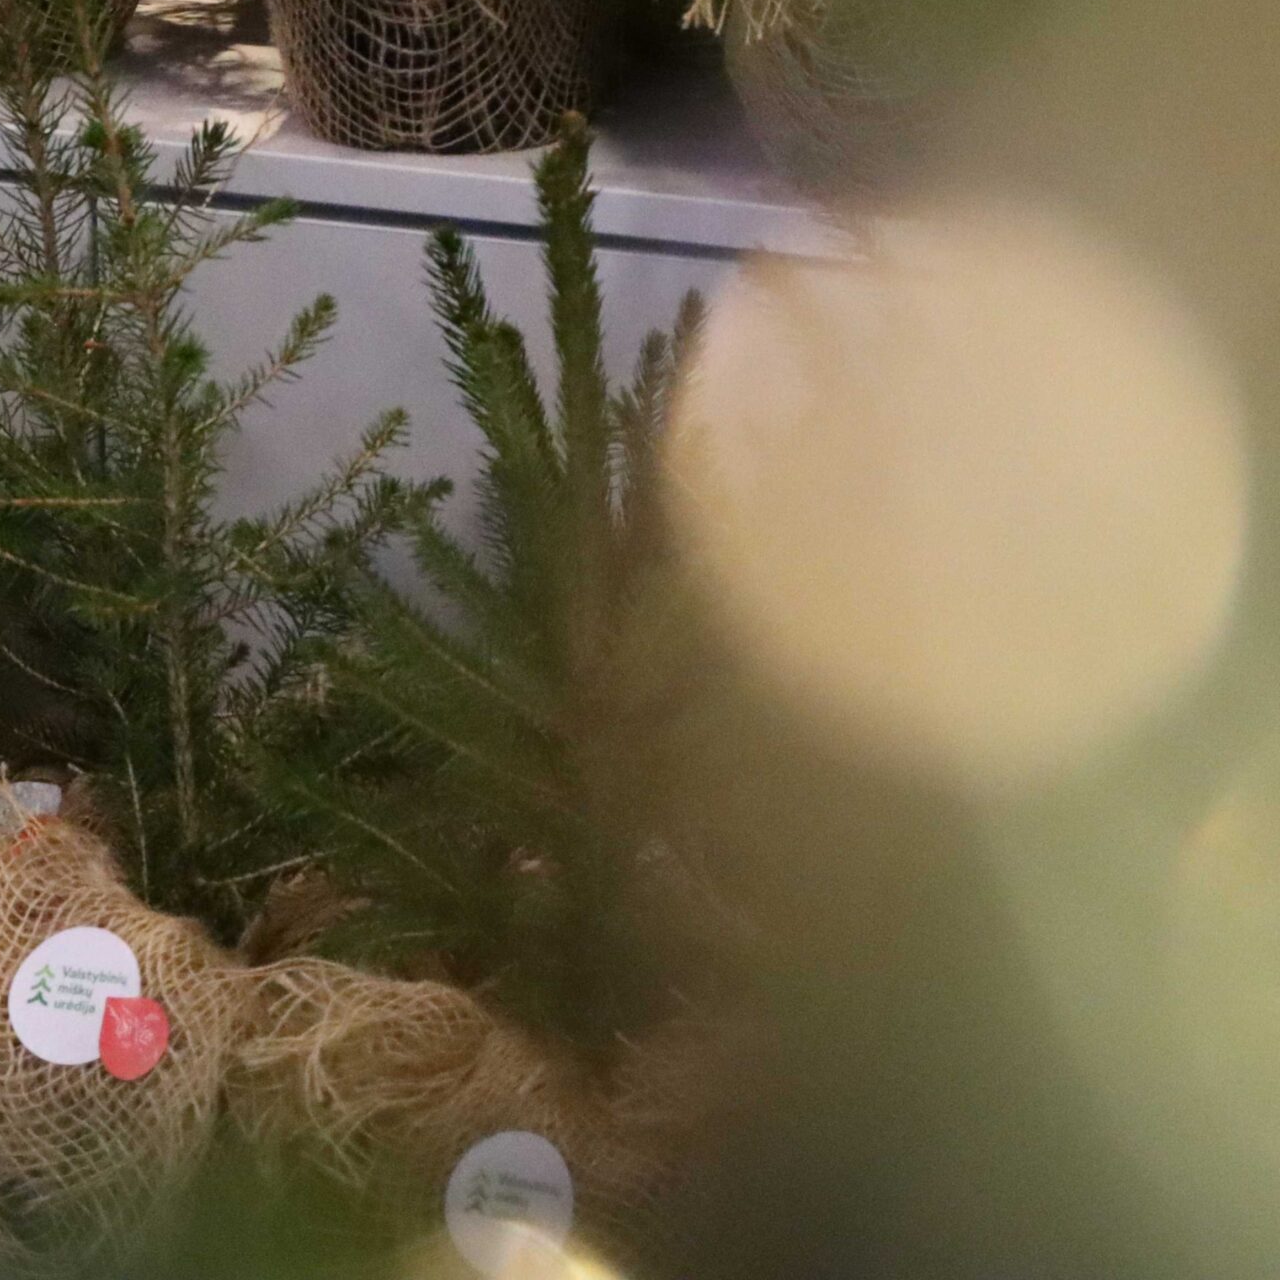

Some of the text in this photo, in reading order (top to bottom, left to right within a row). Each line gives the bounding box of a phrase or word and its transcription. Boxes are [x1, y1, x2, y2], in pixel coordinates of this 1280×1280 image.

[62, 965, 128, 987] Valstybinių
[57, 982, 94, 998] miškų
[53, 998, 96, 1015] urėdija
